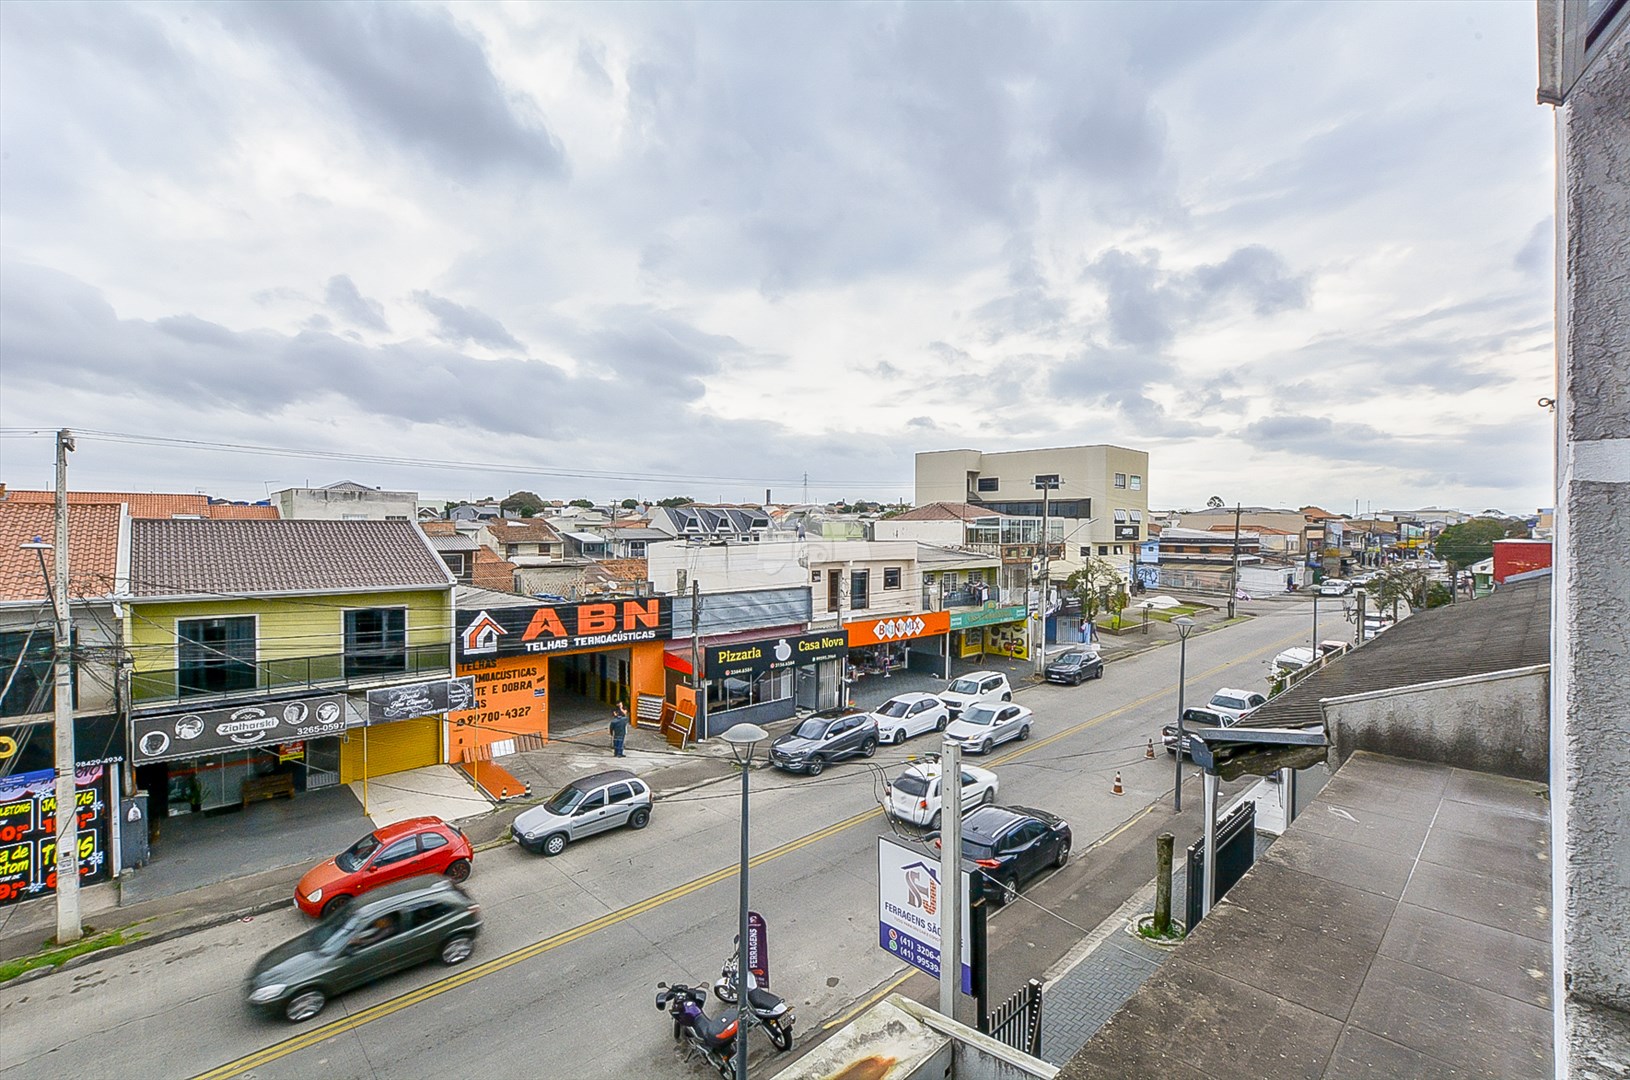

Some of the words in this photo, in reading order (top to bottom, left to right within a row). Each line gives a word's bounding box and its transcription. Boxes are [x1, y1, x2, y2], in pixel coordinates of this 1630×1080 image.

[521, 600, 660, 641] ABN
[525, 641, 568, 652] TELHAS
[573, 630, 656, 647] TERMOACÚSTICAS
[798, 640, 820, 652] Casa
[822, 637, 844, 648] Nova
[718, 647, 762, 663] Pizzaria
[460, 659, 497, 672] TELHAS
[474, 667, 537, 683] RMOACÚSTICAS
[492, 685, 498, 694] E
[502, 681, 533, 693] DOBRA
[467, 706, 531, 726] 99700-4327
[297, 721, 344, 735] 3265-0597
[75, 755, 123, 767] 98429-4936
[0, 803, 31, 816] LETONS
[11, 845, 29, 861] de
[0, 859, 29, 876] etom
[884, 901, 926, 928] FERRAGENS
[749, 928, 758, 968] FERRAGENS
[900, 935, 914, 949] (41)
[916, 944, 941, 963] 3206-4
[900, 948, 915, 961] (41)
[916, 955, 941, 973] 99539-
